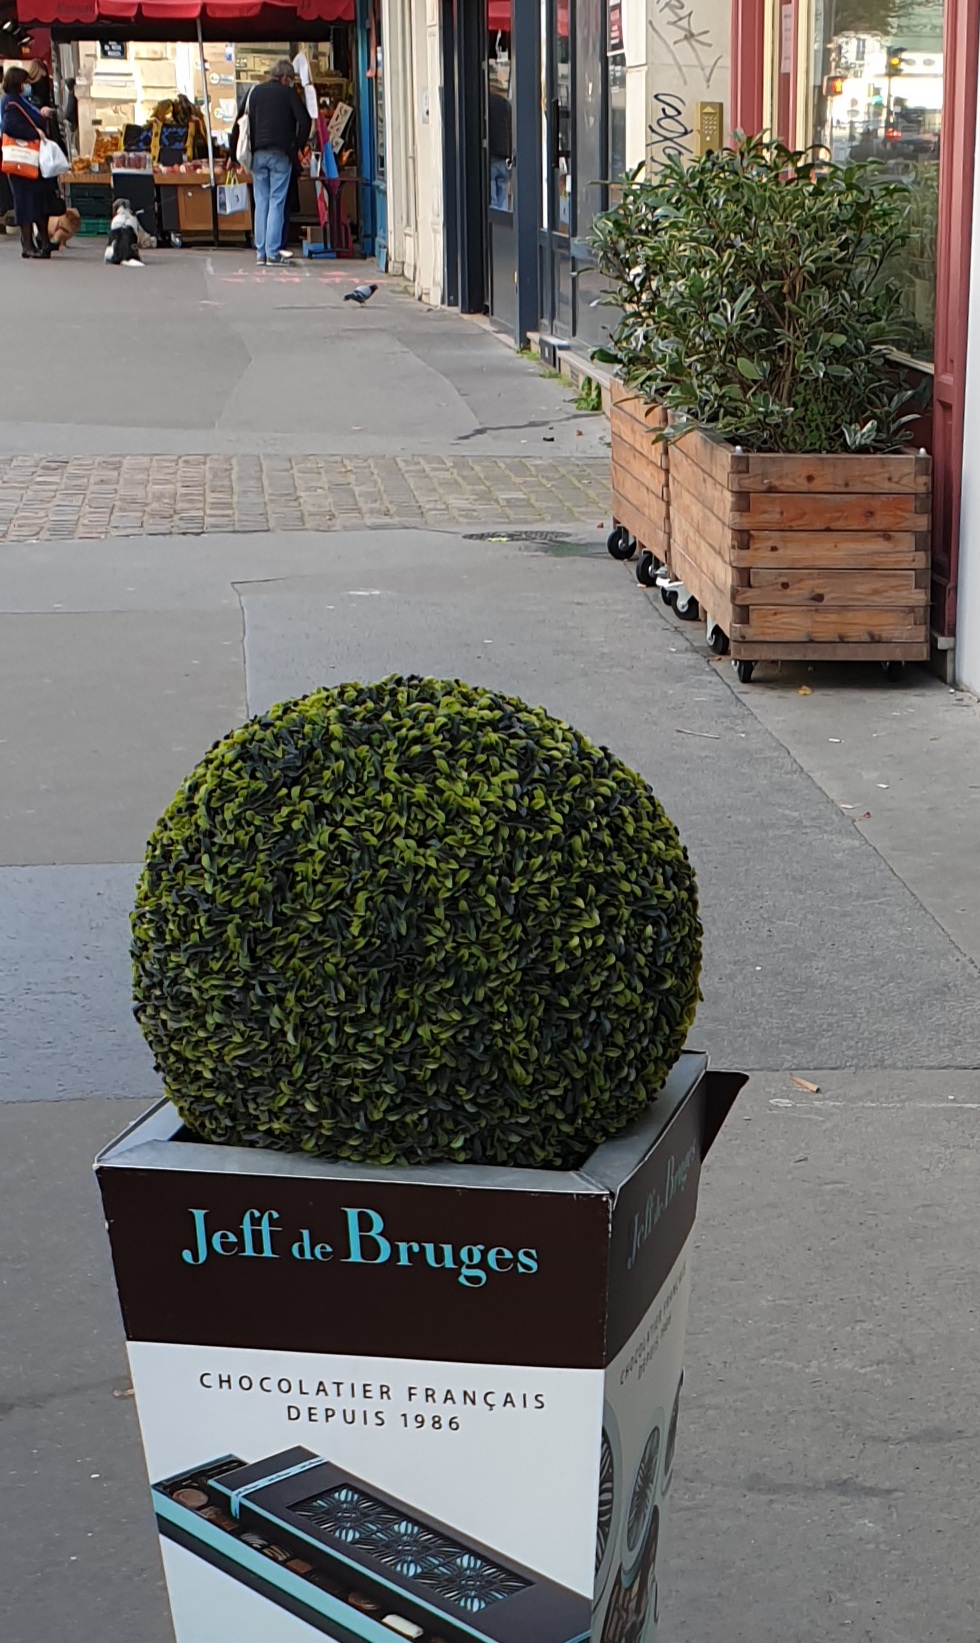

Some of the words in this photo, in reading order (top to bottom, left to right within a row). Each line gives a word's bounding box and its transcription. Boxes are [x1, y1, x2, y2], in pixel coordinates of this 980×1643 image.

[181, 1208, 282, 1265] Jeff
[291, 1229, 333, 1261] de
[340, 1207, 539, 1288] Bruges
[199, 1372, 393, 1402] CHOCOLATIER
[407, 1385, 546, 1413] FRANÇAIS
[287, 1405, 385, 1428] DEPUIS
[400, 1413, 462, 1432] 1986
